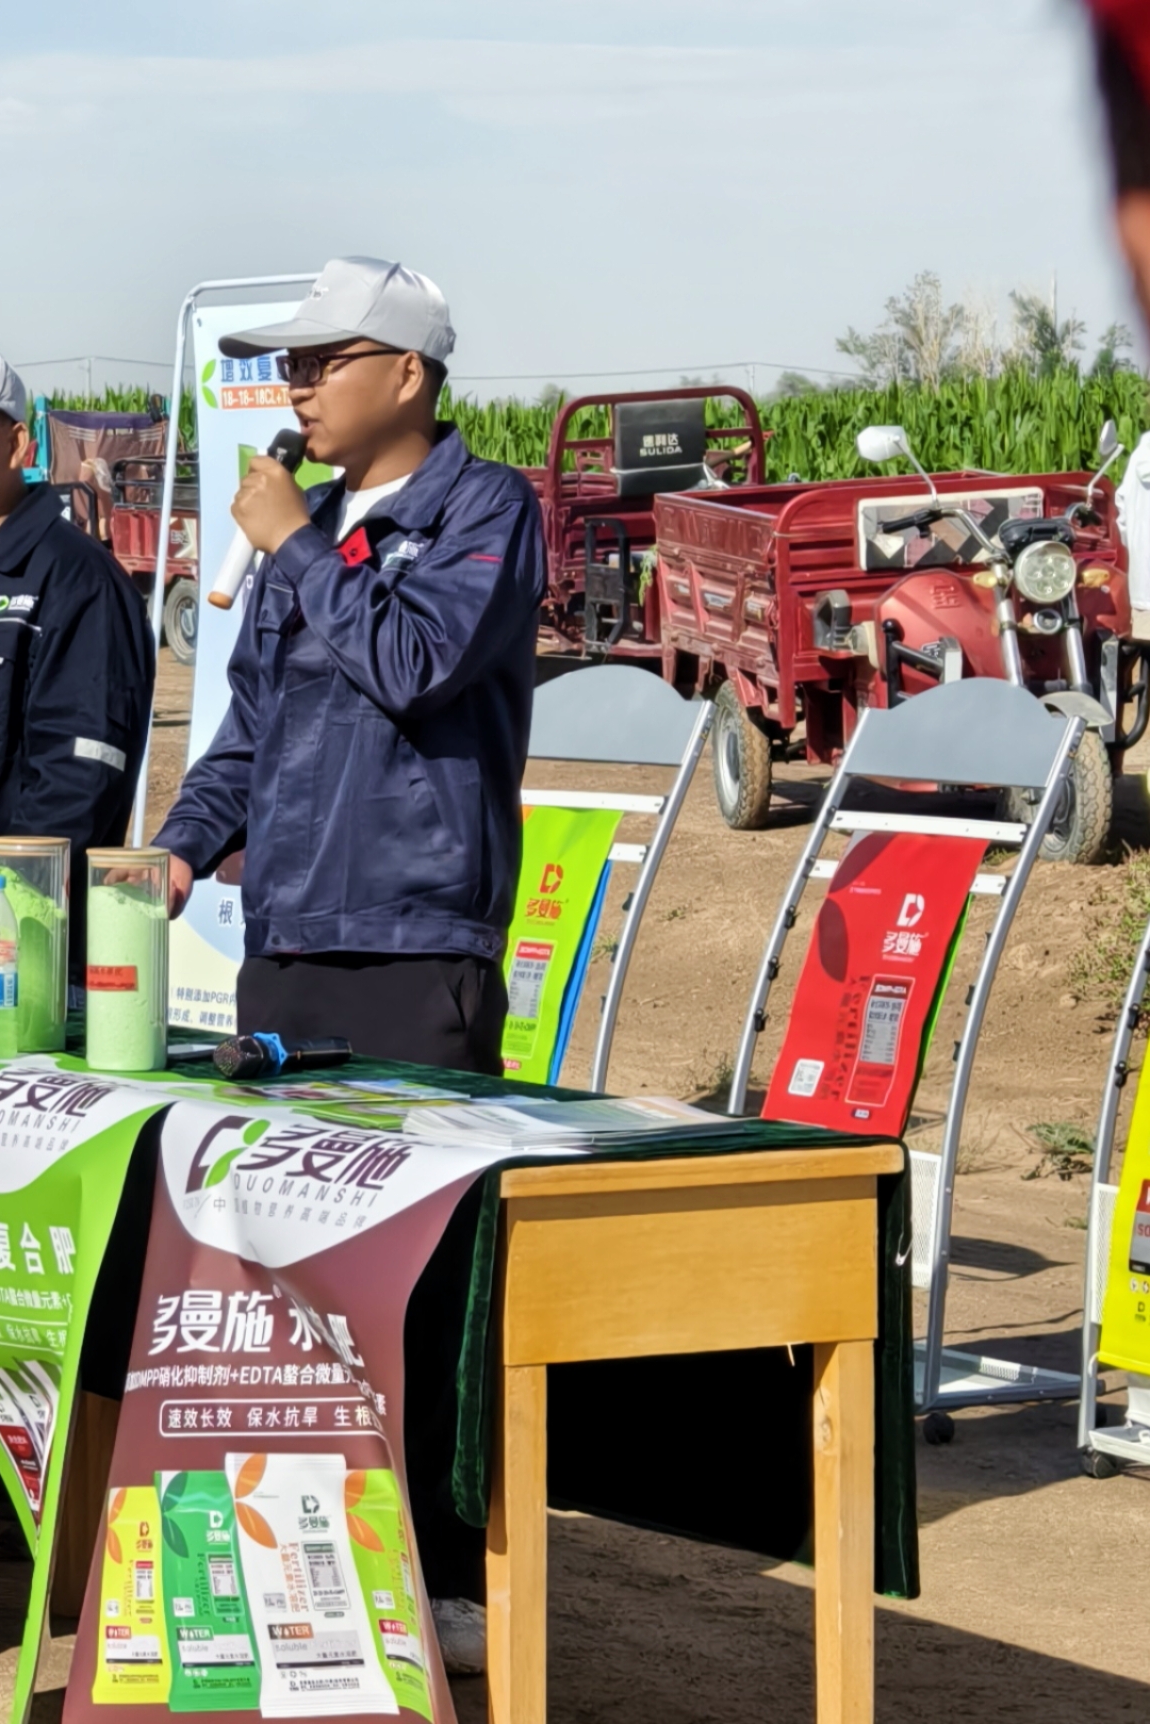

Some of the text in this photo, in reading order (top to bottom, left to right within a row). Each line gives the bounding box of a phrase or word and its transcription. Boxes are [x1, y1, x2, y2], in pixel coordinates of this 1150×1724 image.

[221, 356, 281, 383] 增效复
[640, 446, 683, 457] SULIDA
[233, 1173, 379, 1208] DUOMANSHI
[148, 1289, 274, 1356] 多曼施
[167, 1407, 233, 1429] 速效长效
[246, 1406, 319, 1429] 保水抗旱
[272, 1625, 310, 1637] WATER
